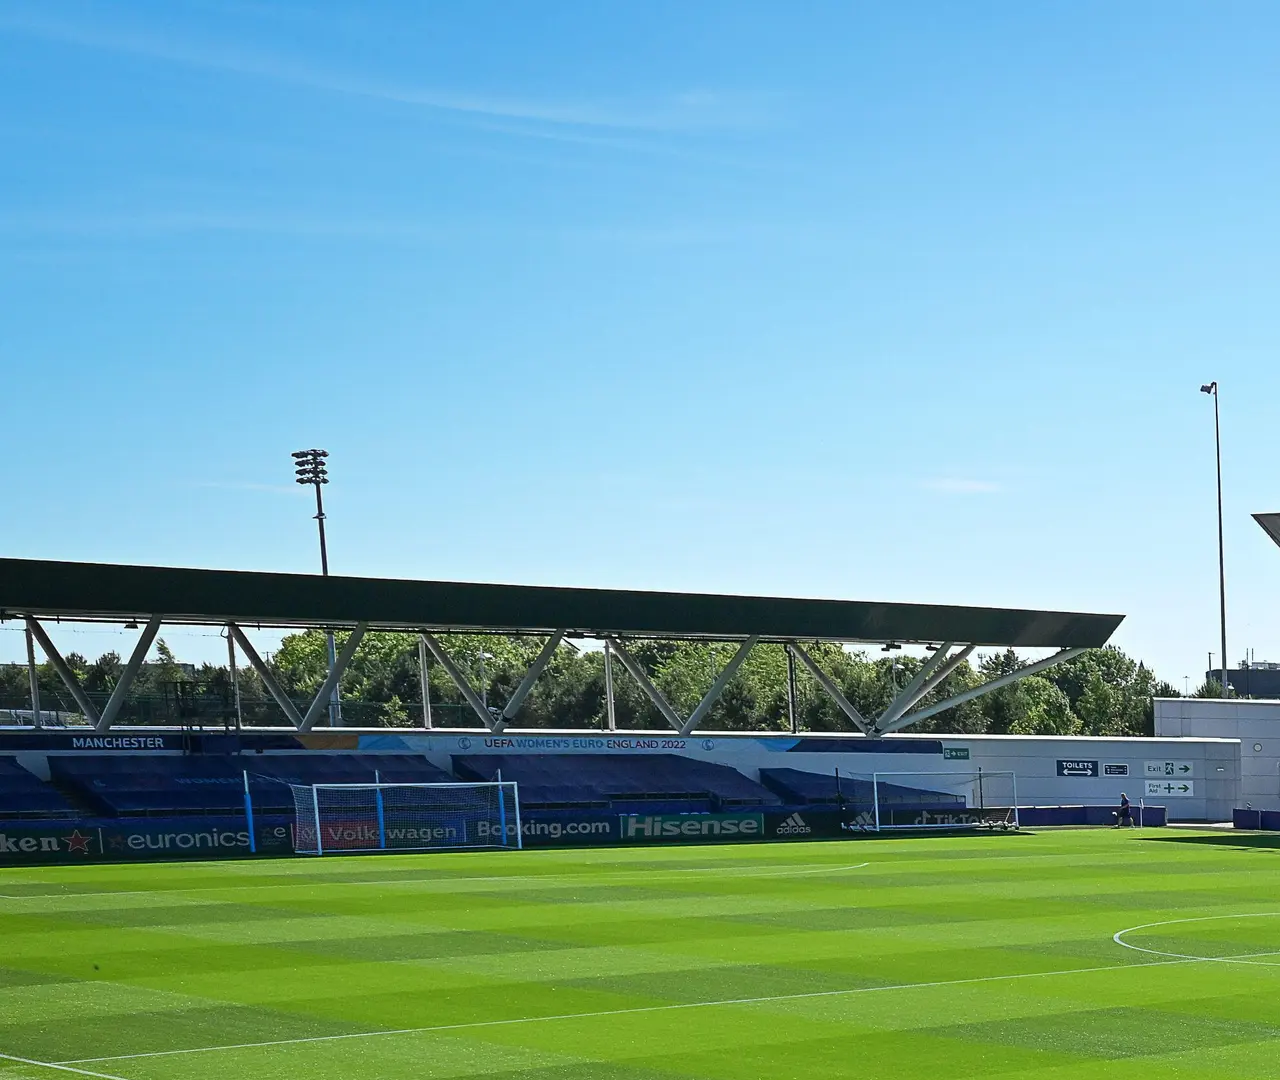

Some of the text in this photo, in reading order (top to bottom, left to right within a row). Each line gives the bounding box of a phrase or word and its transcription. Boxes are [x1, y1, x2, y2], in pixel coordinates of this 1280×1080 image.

[72, 737, 164, 748] MANCHESTER
[484, 739, 686, 749] UEFA WOMEN'S EURO ENGLAND 2022
[328, 822, 457, 845] Volkwagen
[477, 819, 610, 840] Booking.com
[628, 817, 758, 837] Hisense
[776, 824, 812, 834] adidas
[127, 828, 250, 850] euronics
